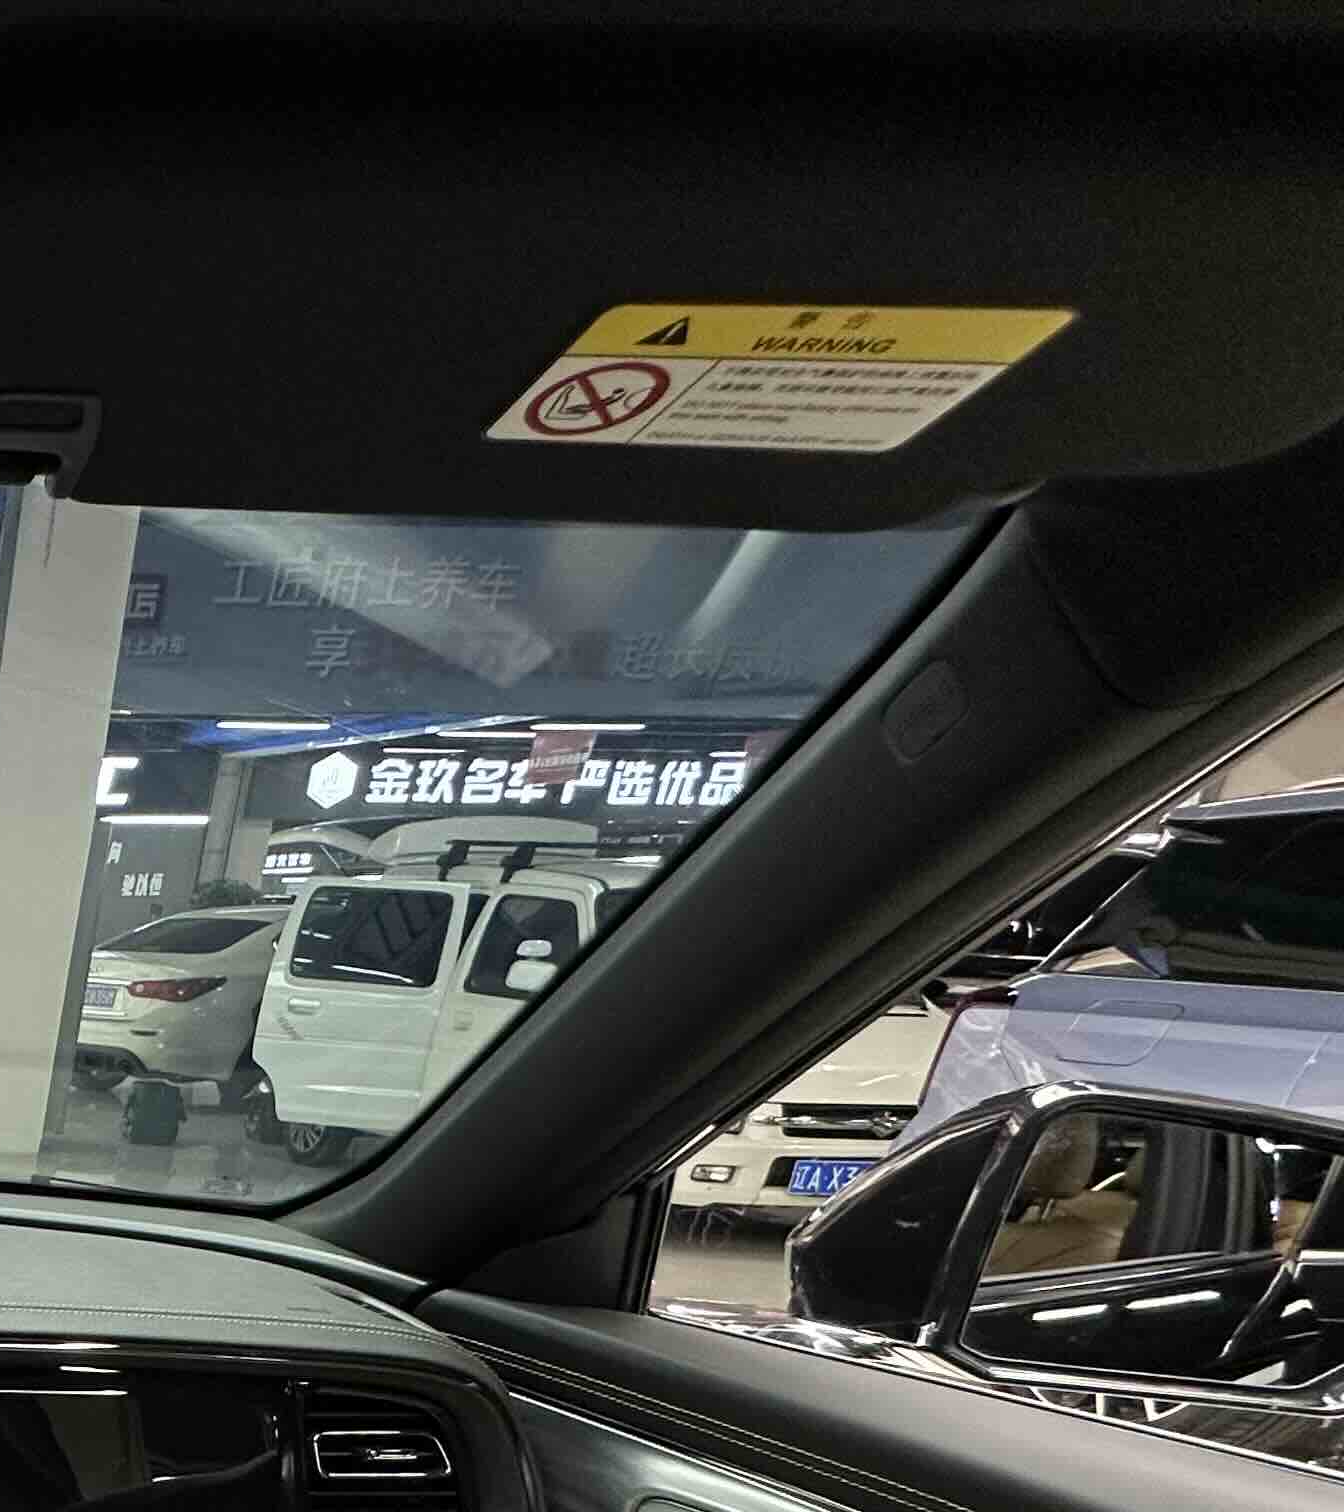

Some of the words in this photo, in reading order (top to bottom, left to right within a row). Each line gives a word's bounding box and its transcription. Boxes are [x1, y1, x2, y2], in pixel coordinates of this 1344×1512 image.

[751, 335, 897, 354] WARNING
[365, 757, 546, 804] 金玖名车
[559, 758, 748, 805] 严选优品
